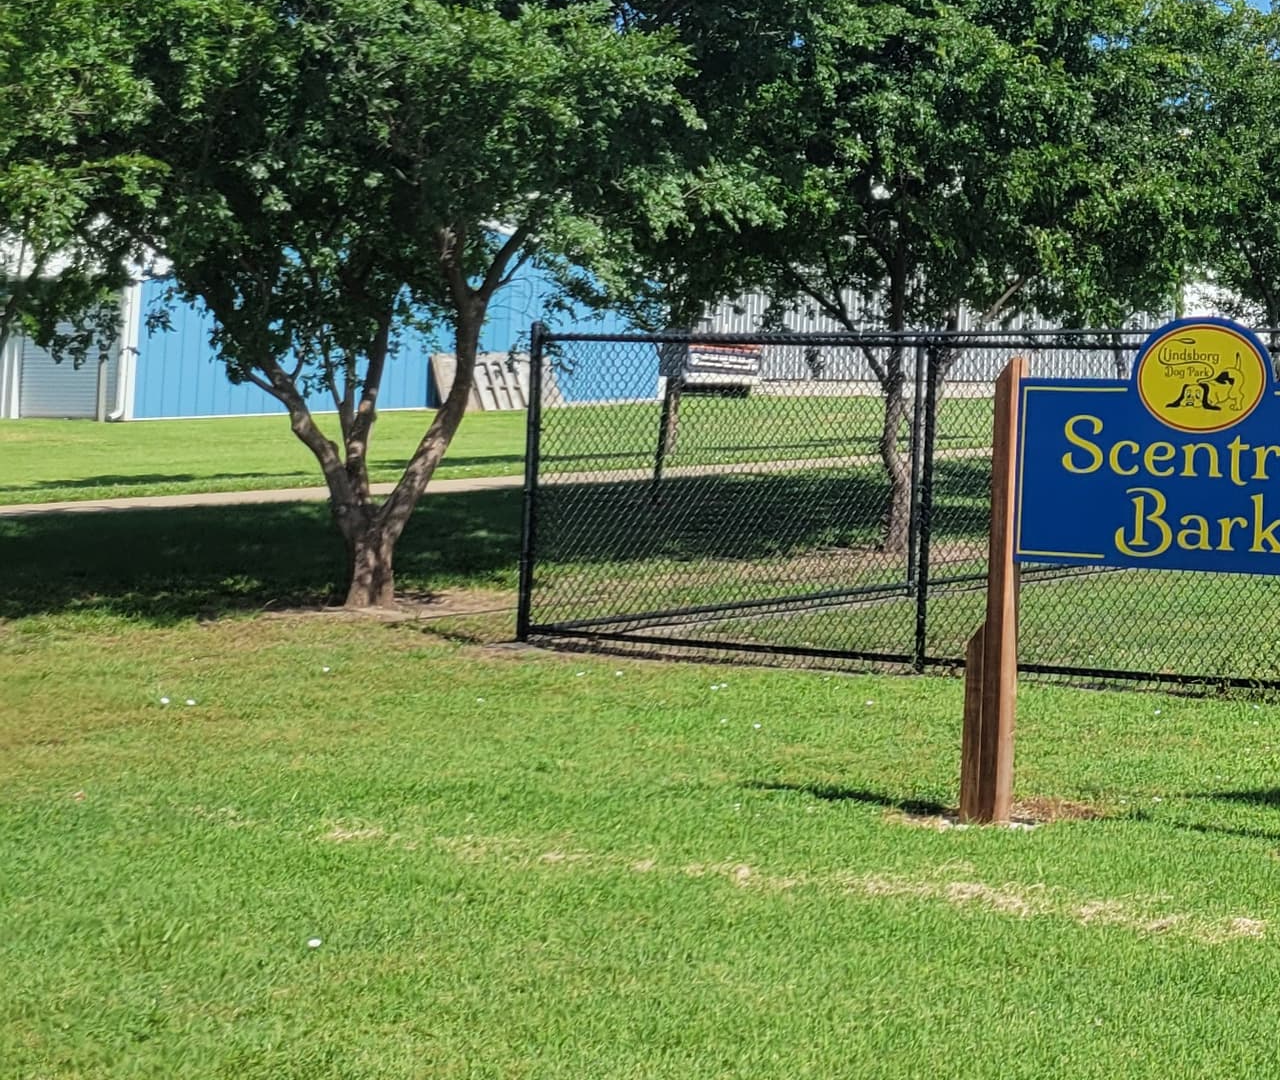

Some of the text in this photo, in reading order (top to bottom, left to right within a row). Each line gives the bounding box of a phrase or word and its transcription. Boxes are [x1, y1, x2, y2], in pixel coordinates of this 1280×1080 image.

[1162, 347, 1220, 365] Lindsborg
[1164, 366, 1210, 378] Dog Park
